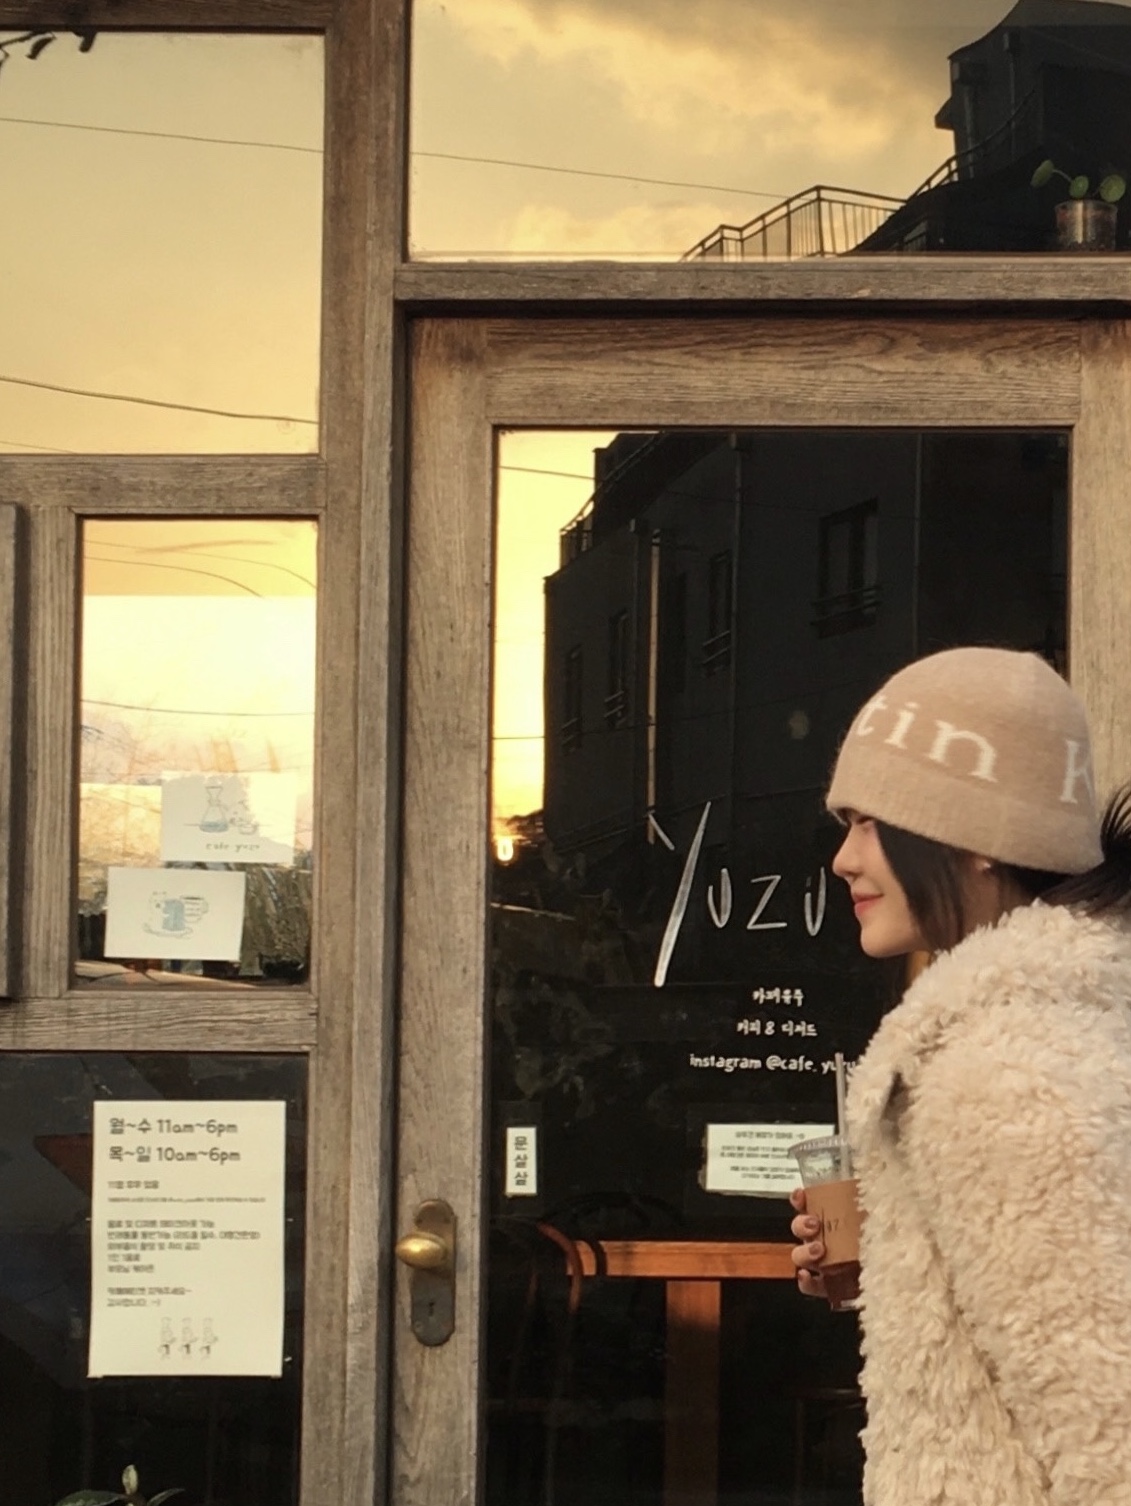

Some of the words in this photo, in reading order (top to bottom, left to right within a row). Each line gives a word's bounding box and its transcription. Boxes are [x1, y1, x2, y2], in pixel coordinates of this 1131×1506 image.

[649, 801, 827, 987] YUZU
[752, 987, 804, 1007] 카페유주
[737, 1019, 761, 1036] 커피
[109, 1118, 151, 1134] 월~수
[156, 1119, 239, 1137] 11am~6pm
[109, 1146, 151, 1163] 목~일
[156, 1147, 241, 1165] 10am~6pm
